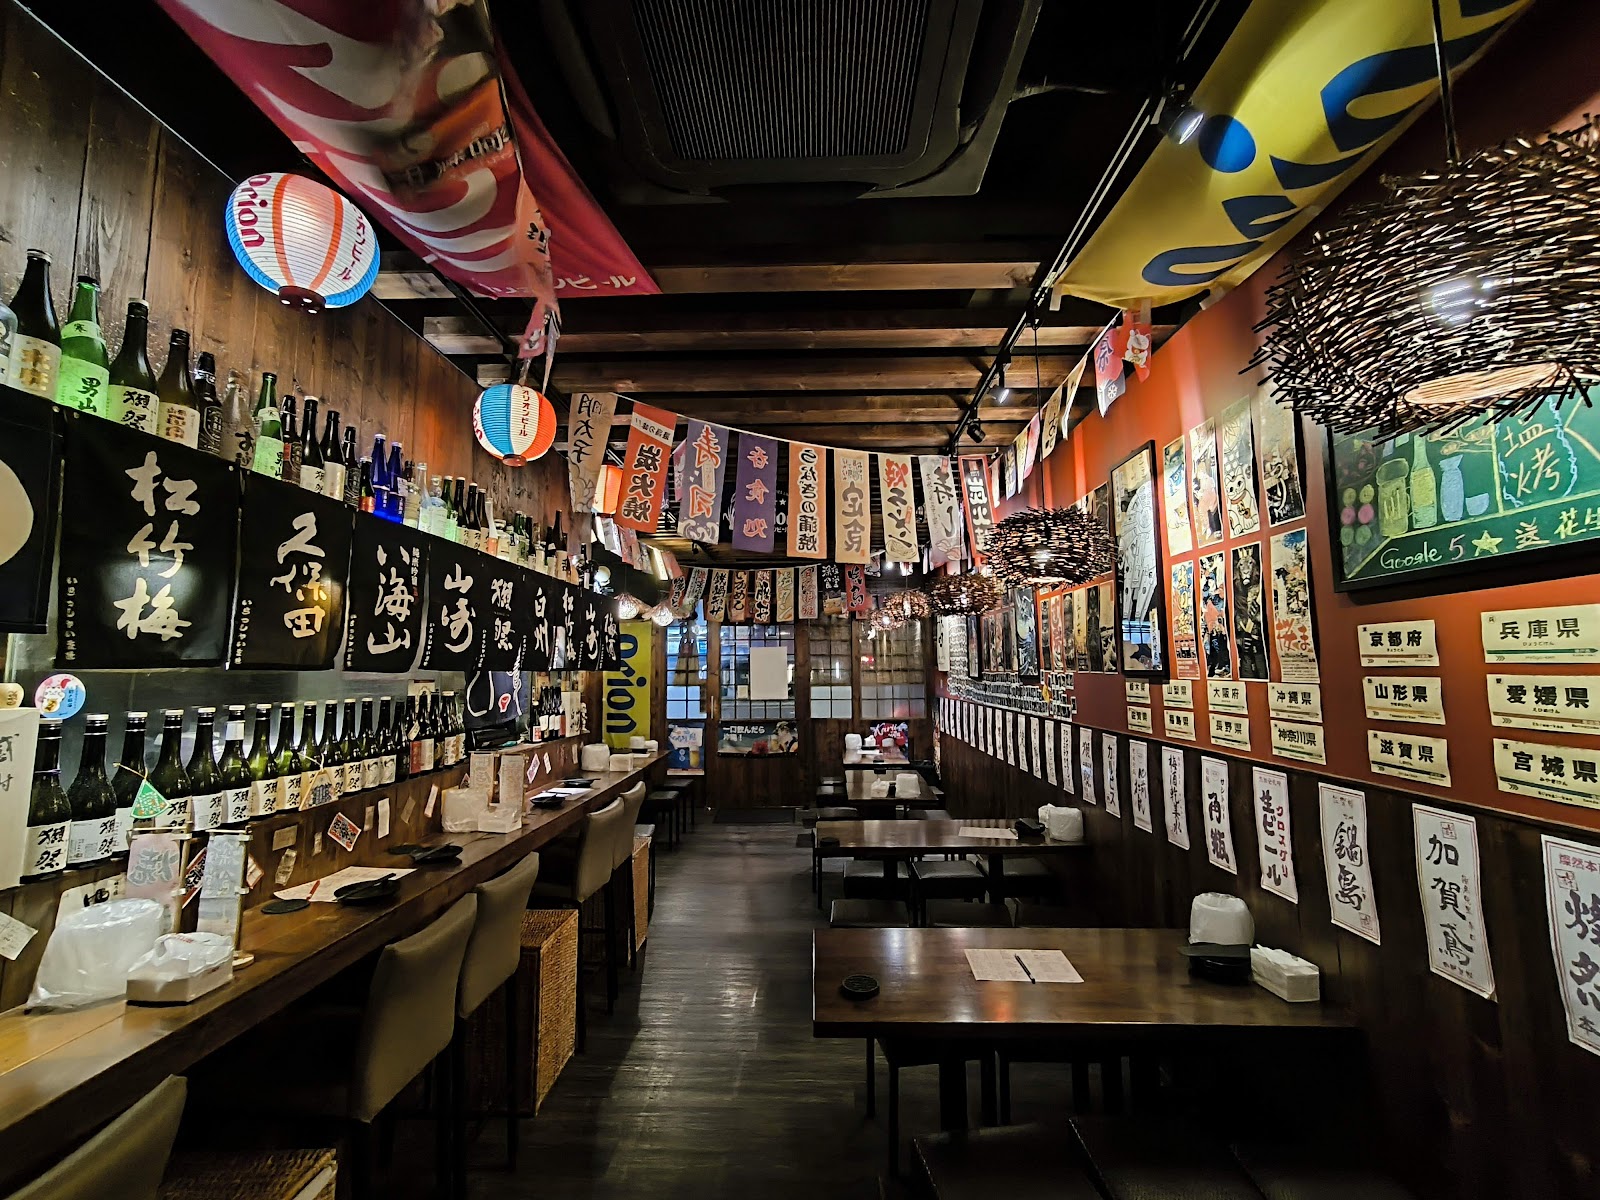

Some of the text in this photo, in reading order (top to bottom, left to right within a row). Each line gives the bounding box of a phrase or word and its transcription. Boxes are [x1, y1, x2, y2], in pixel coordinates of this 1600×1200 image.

[238, 175, 272, 248] Orion
[77, 376, 102, 413] 男山
[521, 390, 529, 437] オリオンビール
[114, 450, 201, 641] 松竹梅
[1380, 541, 1442, 569] Google
[1450, 533, 1466, 561] 5
[269, 511, 326, 640] 久保田
[367, 544, 416, 655] 八海山
[534, 586, 550, 658] 白州
[1369, 630, 1422, 647] 京都府
[1500, 618, 1580, 640] 兵庫県
[1213, 687, 1240, 699] 大阪府
[1276, 690, 1312, 705] 沖縄県
[1375, 683, 1428, 703] 山形県
[1506, 685, 1590, 708] 愛媛県
[1216, 720, 1242, 735] 長野県
[1278, 728, 1317, 746] 神奈川県
[1380, 739, 1434, 763] 滋賀県
[1512, 751, 1599, 784] 宮城県
[34, 827, 65, 870] 獺祭
[1260, 789, 1282, 887] 生ビール
[1558, 853, 1600, 873] 燦然本
